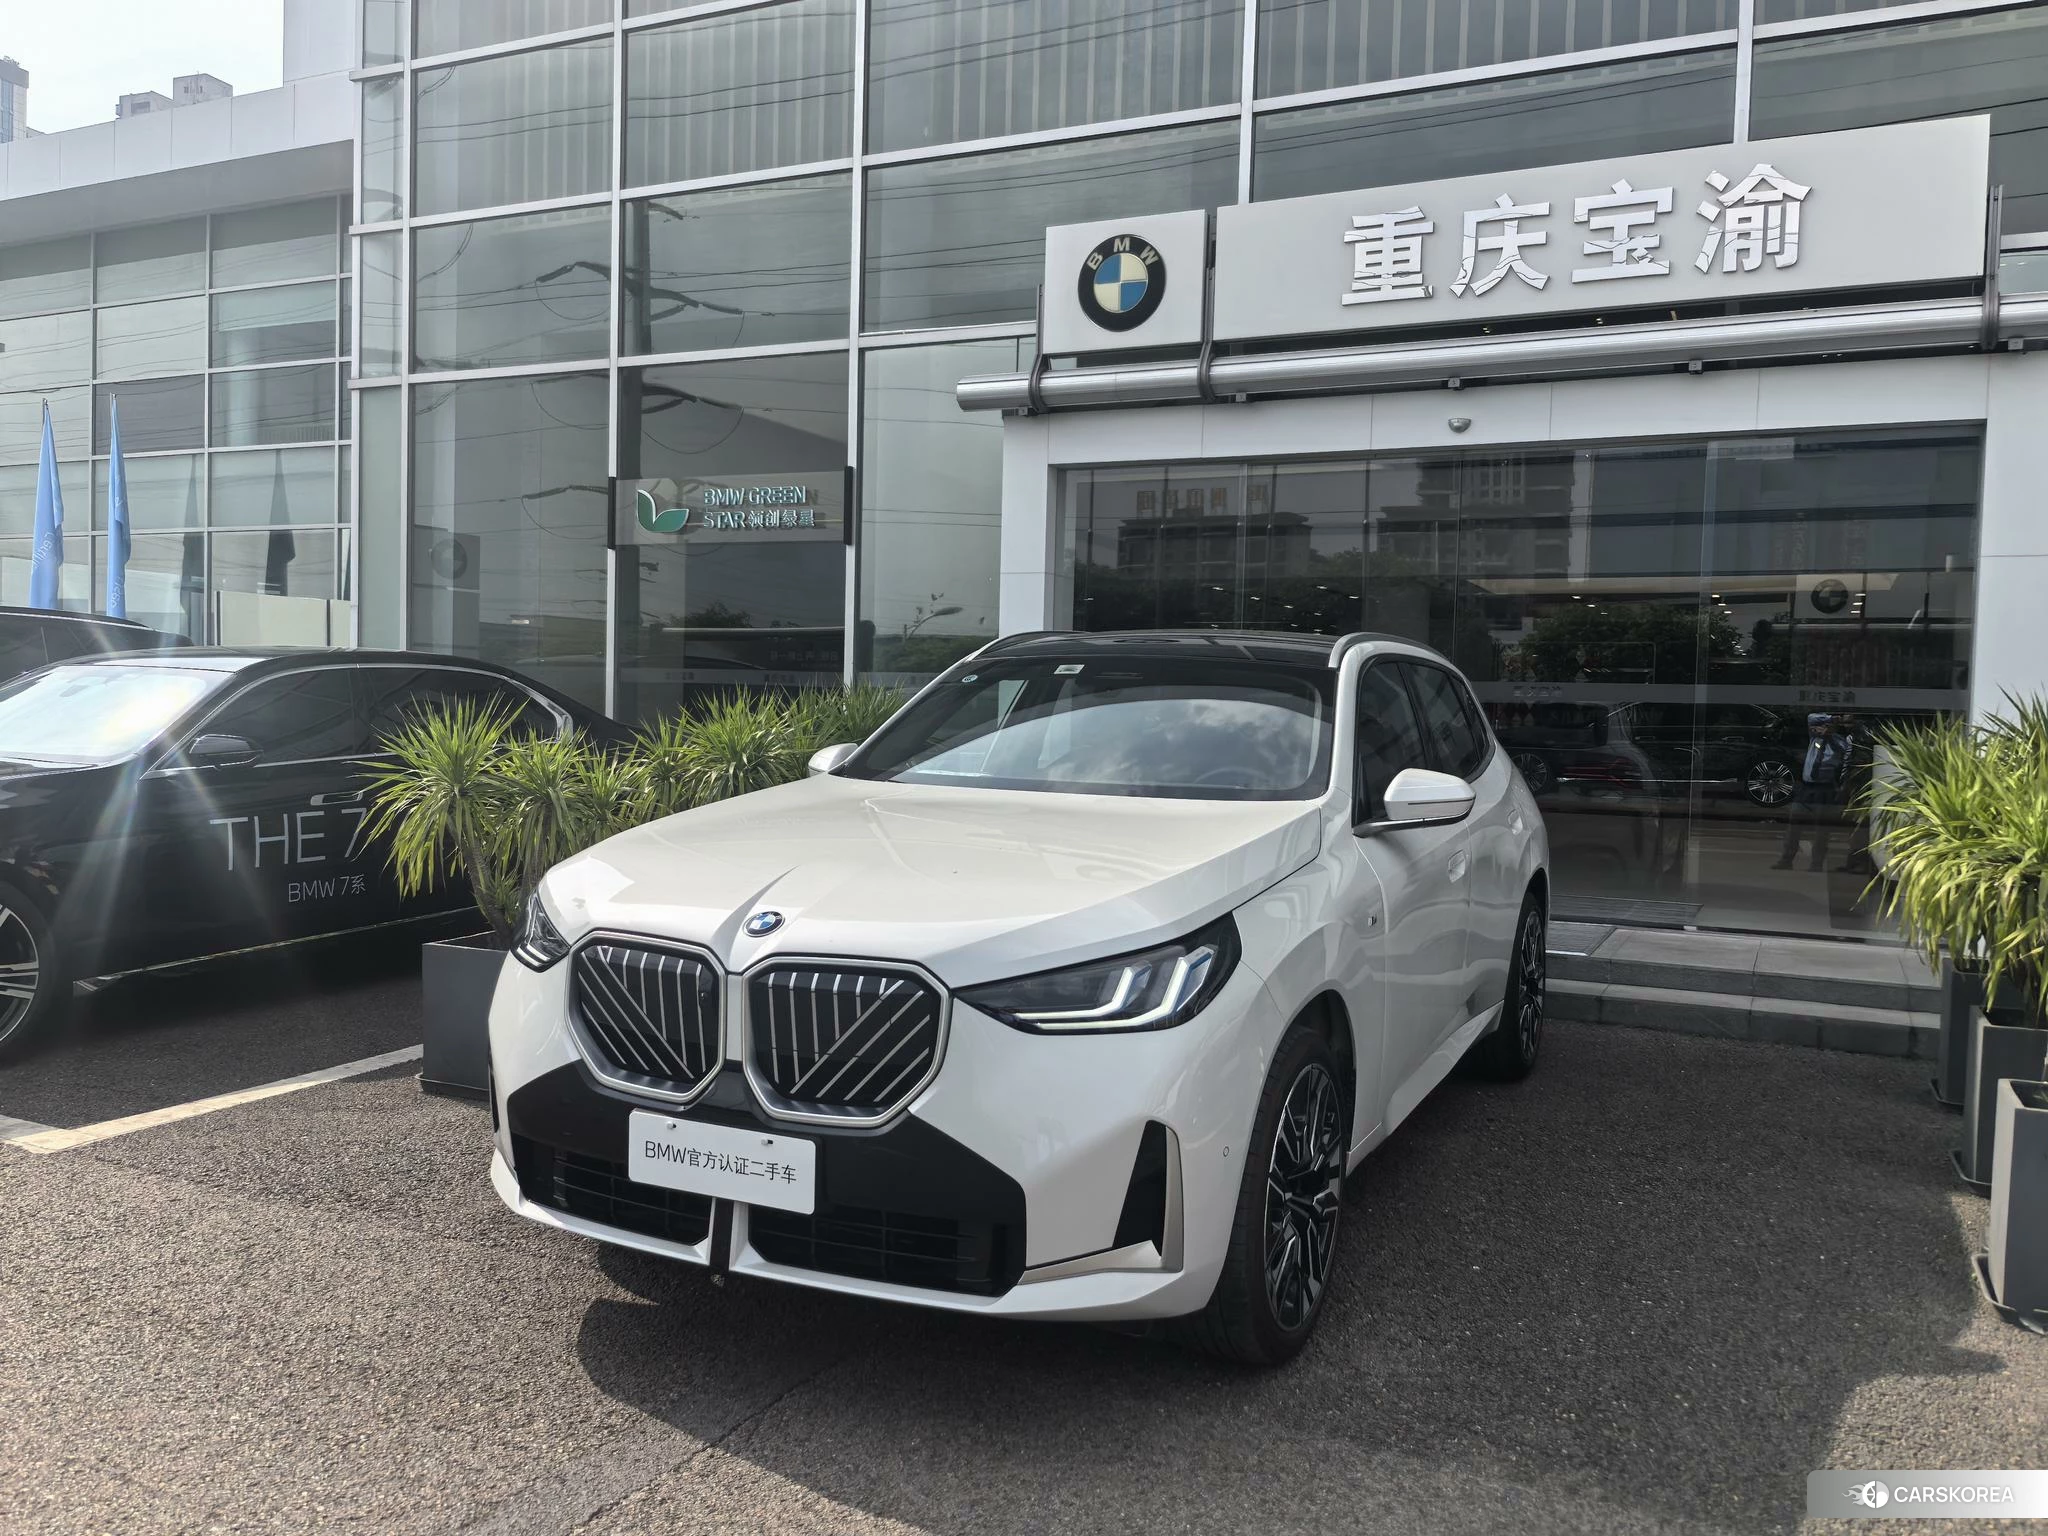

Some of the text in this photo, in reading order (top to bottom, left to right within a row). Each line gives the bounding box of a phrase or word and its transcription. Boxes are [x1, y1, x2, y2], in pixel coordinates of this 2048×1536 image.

[1341, 163, 1812, 306] 重庆宝渝
[1086, 236, 1160, 271] BMW
[704, 485, 806, 506] BMW GREEN
[703, 510, 746, 529] STAR
[209, 807, 367, 871] THE 7
[288, 874, 367, 903] BMW 7系
